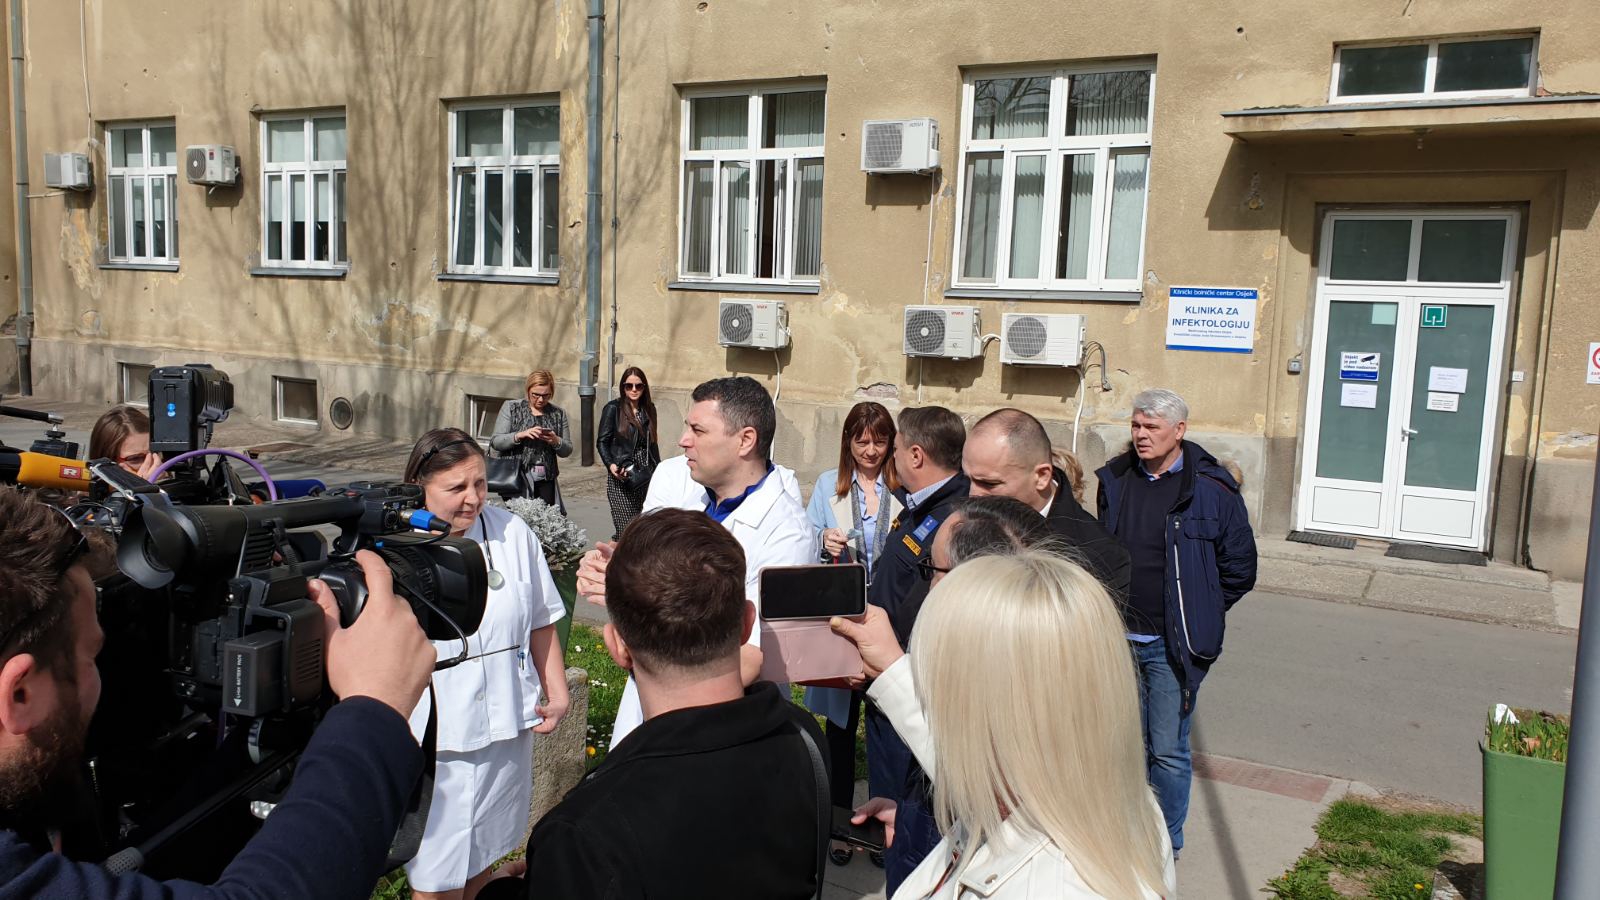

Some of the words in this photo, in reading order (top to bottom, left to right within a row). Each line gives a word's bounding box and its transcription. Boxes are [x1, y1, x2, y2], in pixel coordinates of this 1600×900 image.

[1235, 290, 1254, 298] Osijek
[1185, 306, 1224, 315] KLINIKA
[1226, 307, 1239, 315] ZA
[1172, 318, 1250, 329] INFEKTOLOGIJU
